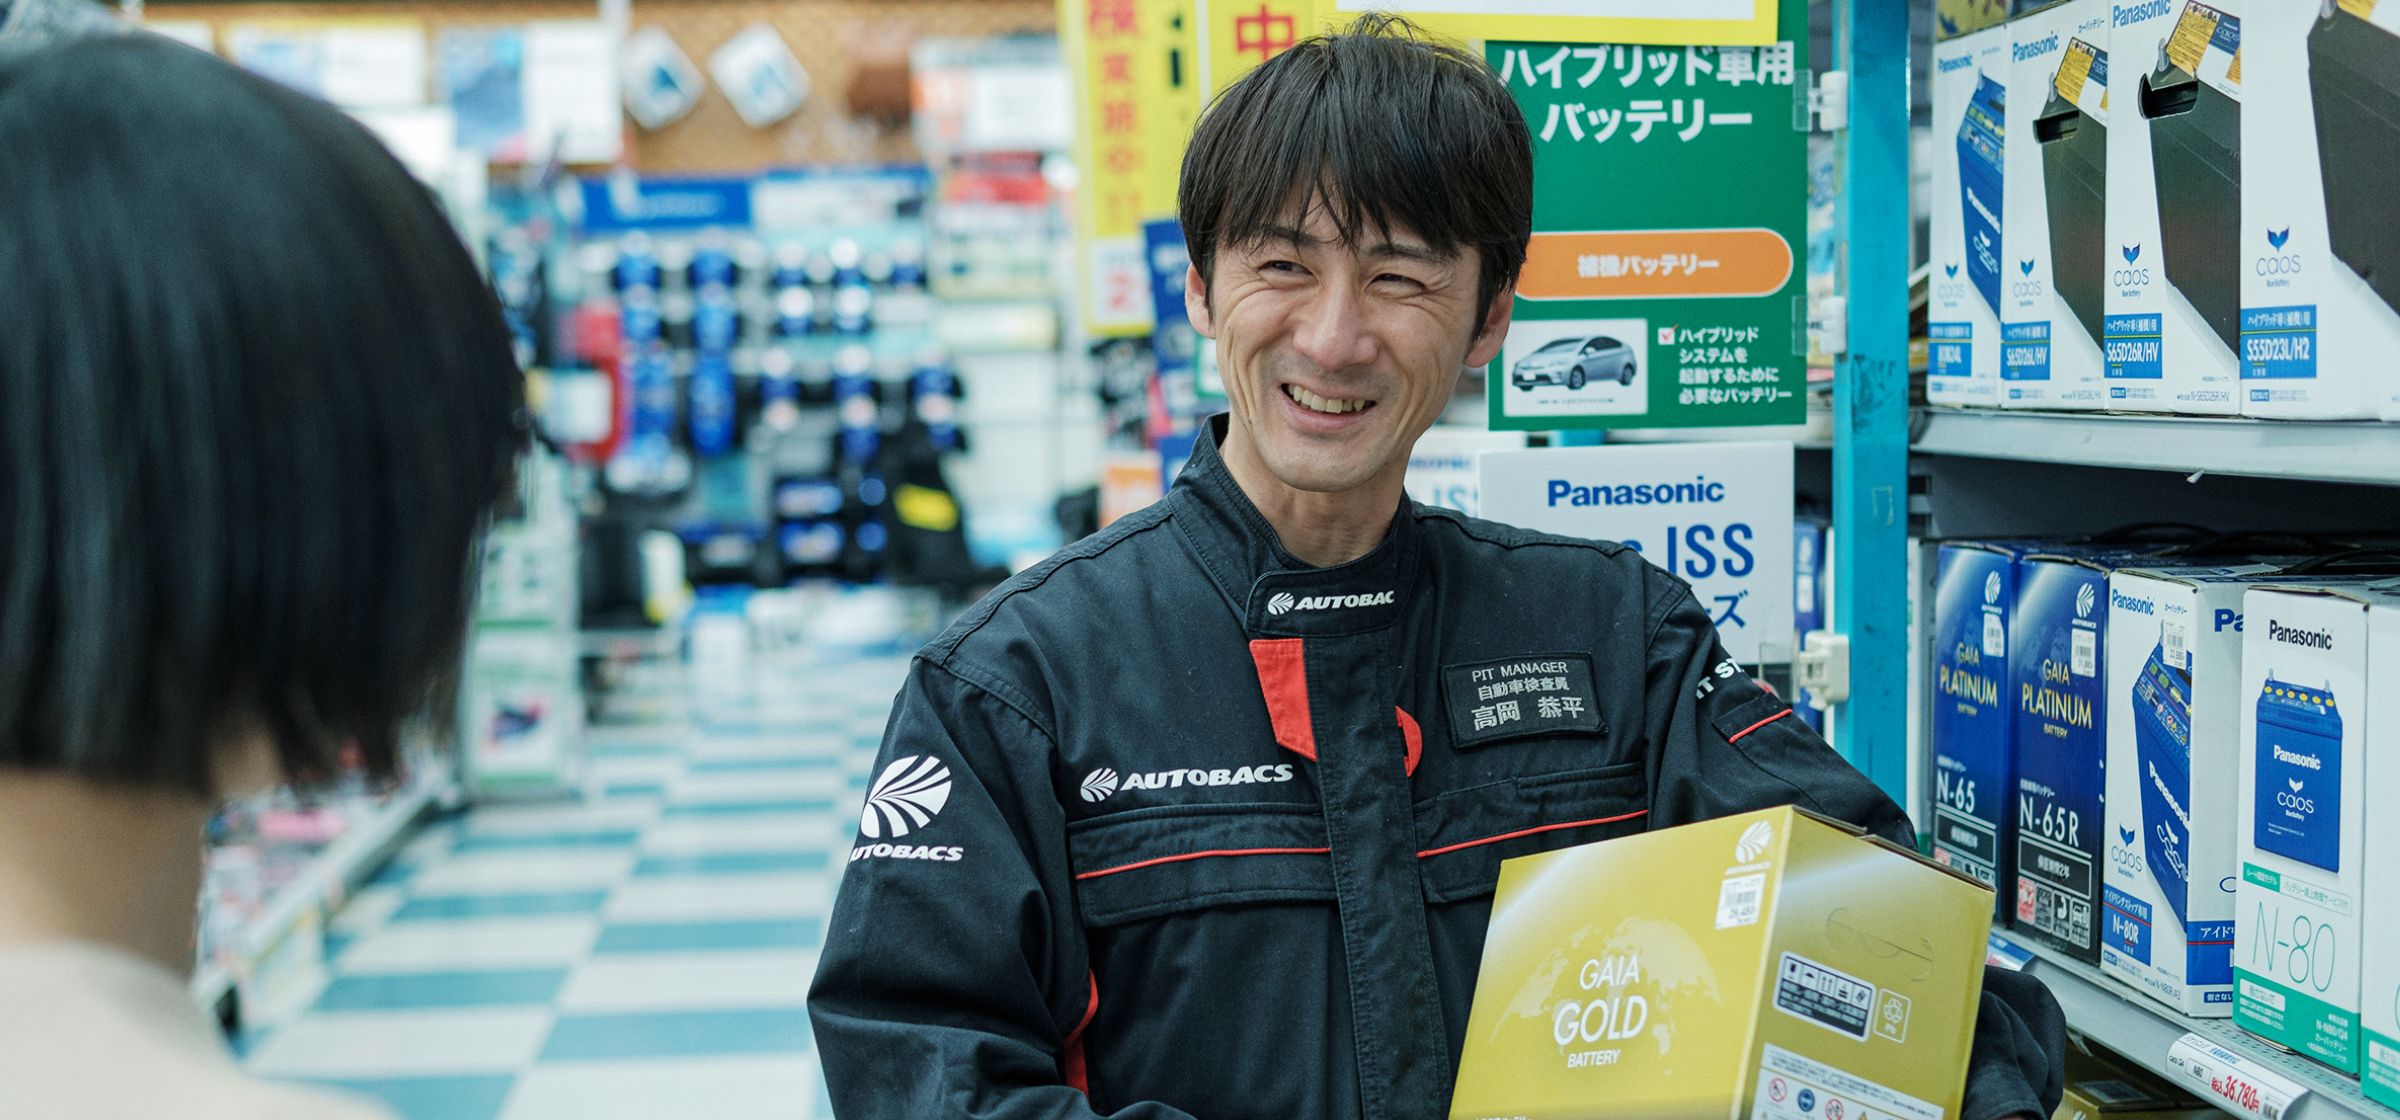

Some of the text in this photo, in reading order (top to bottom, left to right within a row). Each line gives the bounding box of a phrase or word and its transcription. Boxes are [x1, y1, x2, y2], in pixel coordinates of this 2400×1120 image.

[2112, 0, 2171, 28] Panasonic
[2012, 31, 2059, 63] Panasonic
[1500, 41, 1795, 88] ハイブリッド車用
[1539, 99, 1753, 143] バッテリー
[1578, 254, 1719, 279] 補機バッテリー
[2114, 268, 2149, 287] caos
[2256, 255, 2301, 276] caos
[2013, 281, 2042, 297] caos
[1679, 326, 1760, 344] ハイブリッド
[2247, 336, 2310, 361] S55D23L/H2
[1679, 347, 1749, 364] システムを
[2107, 341, 2159, 363] S65D26R/HV
[1679, 367, 1780, 386] 起動するために
[1679, 387, 1793, 406] 必要なバッテリー
[1548, 475, 1725, 507] Panasonic
[1667, 523, 1755, 578] ISS
[2112, 589, 2154, 616] Panasonic
[2269, 619, 2332, 650] Panasonic
[1957, 642, 1980, 666] GAIA
[1471, 660, 1569, 683] PIT MANAGER
[2042, 658, 2070, 686] GAIA
[1477, 677, 1571, 702] 自動車検査員
[1940, 665, 1998, 708] PLATINUM
[1471, 700, 1522, 732] 高岡
[2022, 682, 2092, 730] PLATINUM
[2043, 724, 2068, 739] BATTERY
[2273, 744, 2321, 771] Panasonic
[1120, 763, 1295, 793] AUTOBACS
[2277, 791, 2315, 815] caos
[2111, 845, 2143, 873] caos
[2112, 913, 2139, 944] N-80R
[2252, 900, 2336, 993] N-80
[1580, 954, 1641, 991] GAIA
[1553, 995, 1649, 1046] GOLD
[1567, 1049, 1622, 1069] BATTERY
